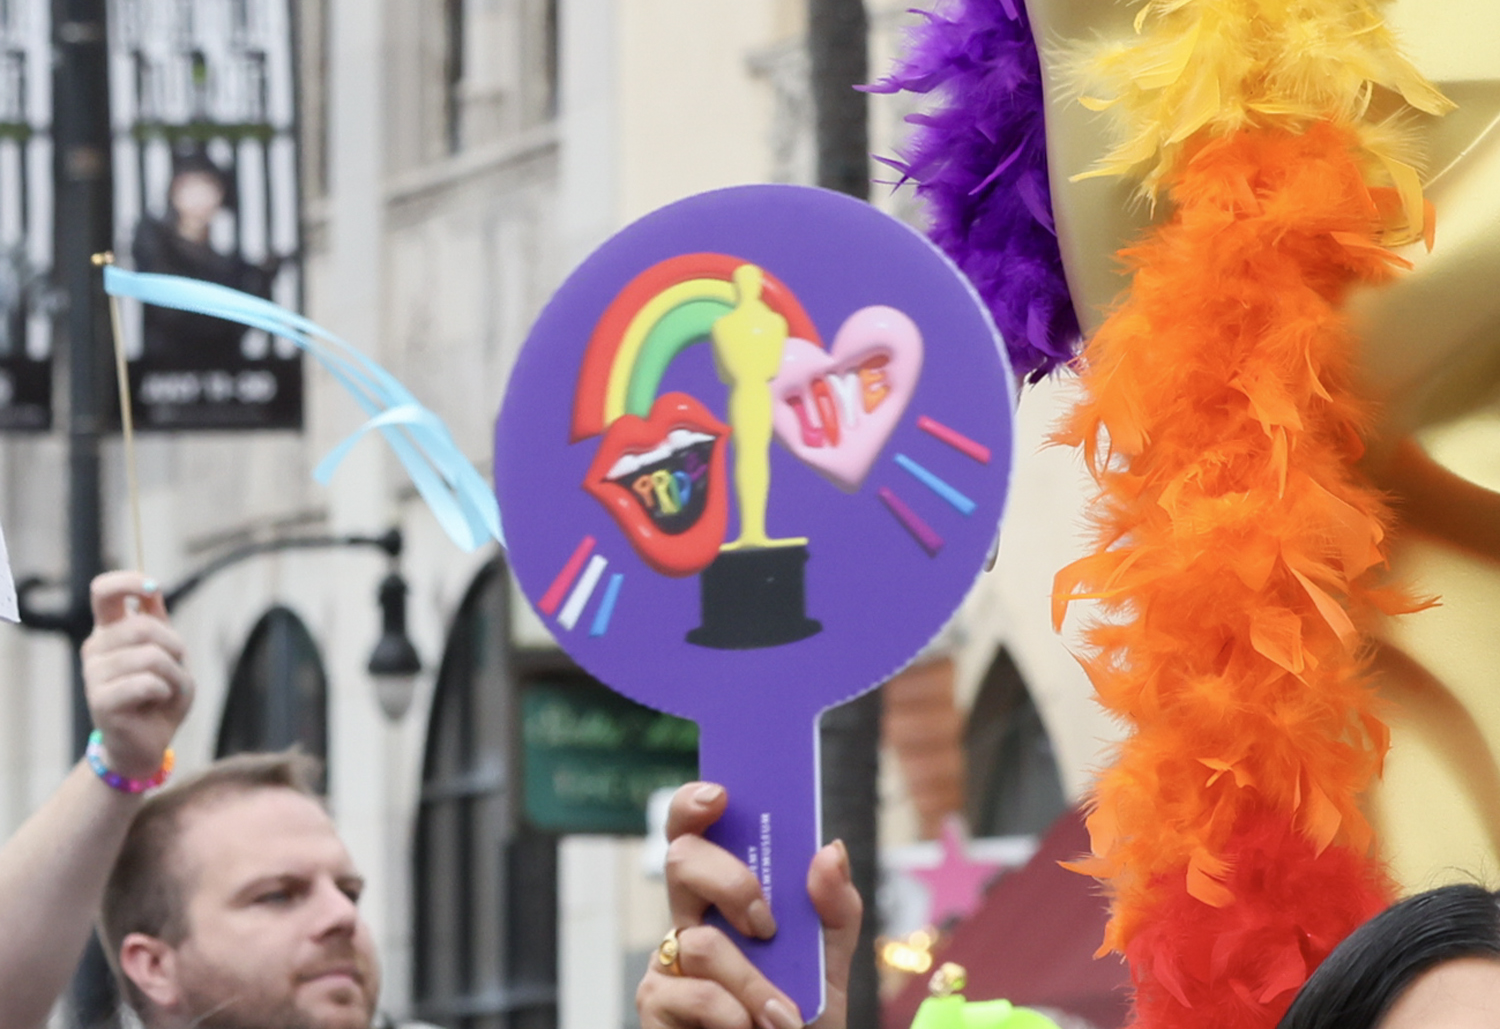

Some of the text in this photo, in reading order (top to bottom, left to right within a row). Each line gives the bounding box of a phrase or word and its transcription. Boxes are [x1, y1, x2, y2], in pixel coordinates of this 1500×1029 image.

[785, 356, 890, 448] LOVE
[632, 453, 708, 514] PRIDE
[760, 812, 772, 905] DEMYMUSEUM
